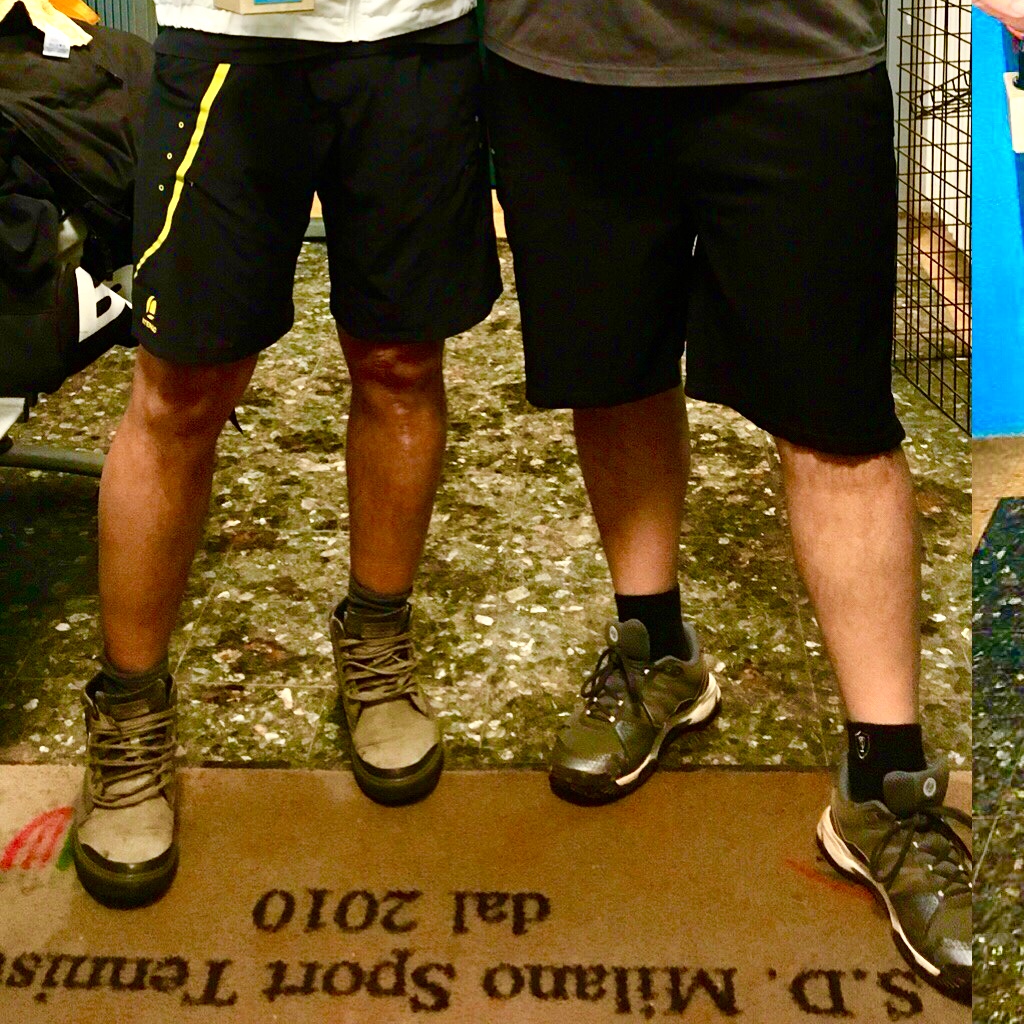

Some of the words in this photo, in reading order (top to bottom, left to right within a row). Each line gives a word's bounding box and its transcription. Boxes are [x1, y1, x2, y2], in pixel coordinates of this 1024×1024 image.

[251, 889, 424, 934] 2010
[450, 890, 551, 936] dal
[262, 947, 457, 1014] Sport
[480, 962, 741, 1020] Milano
